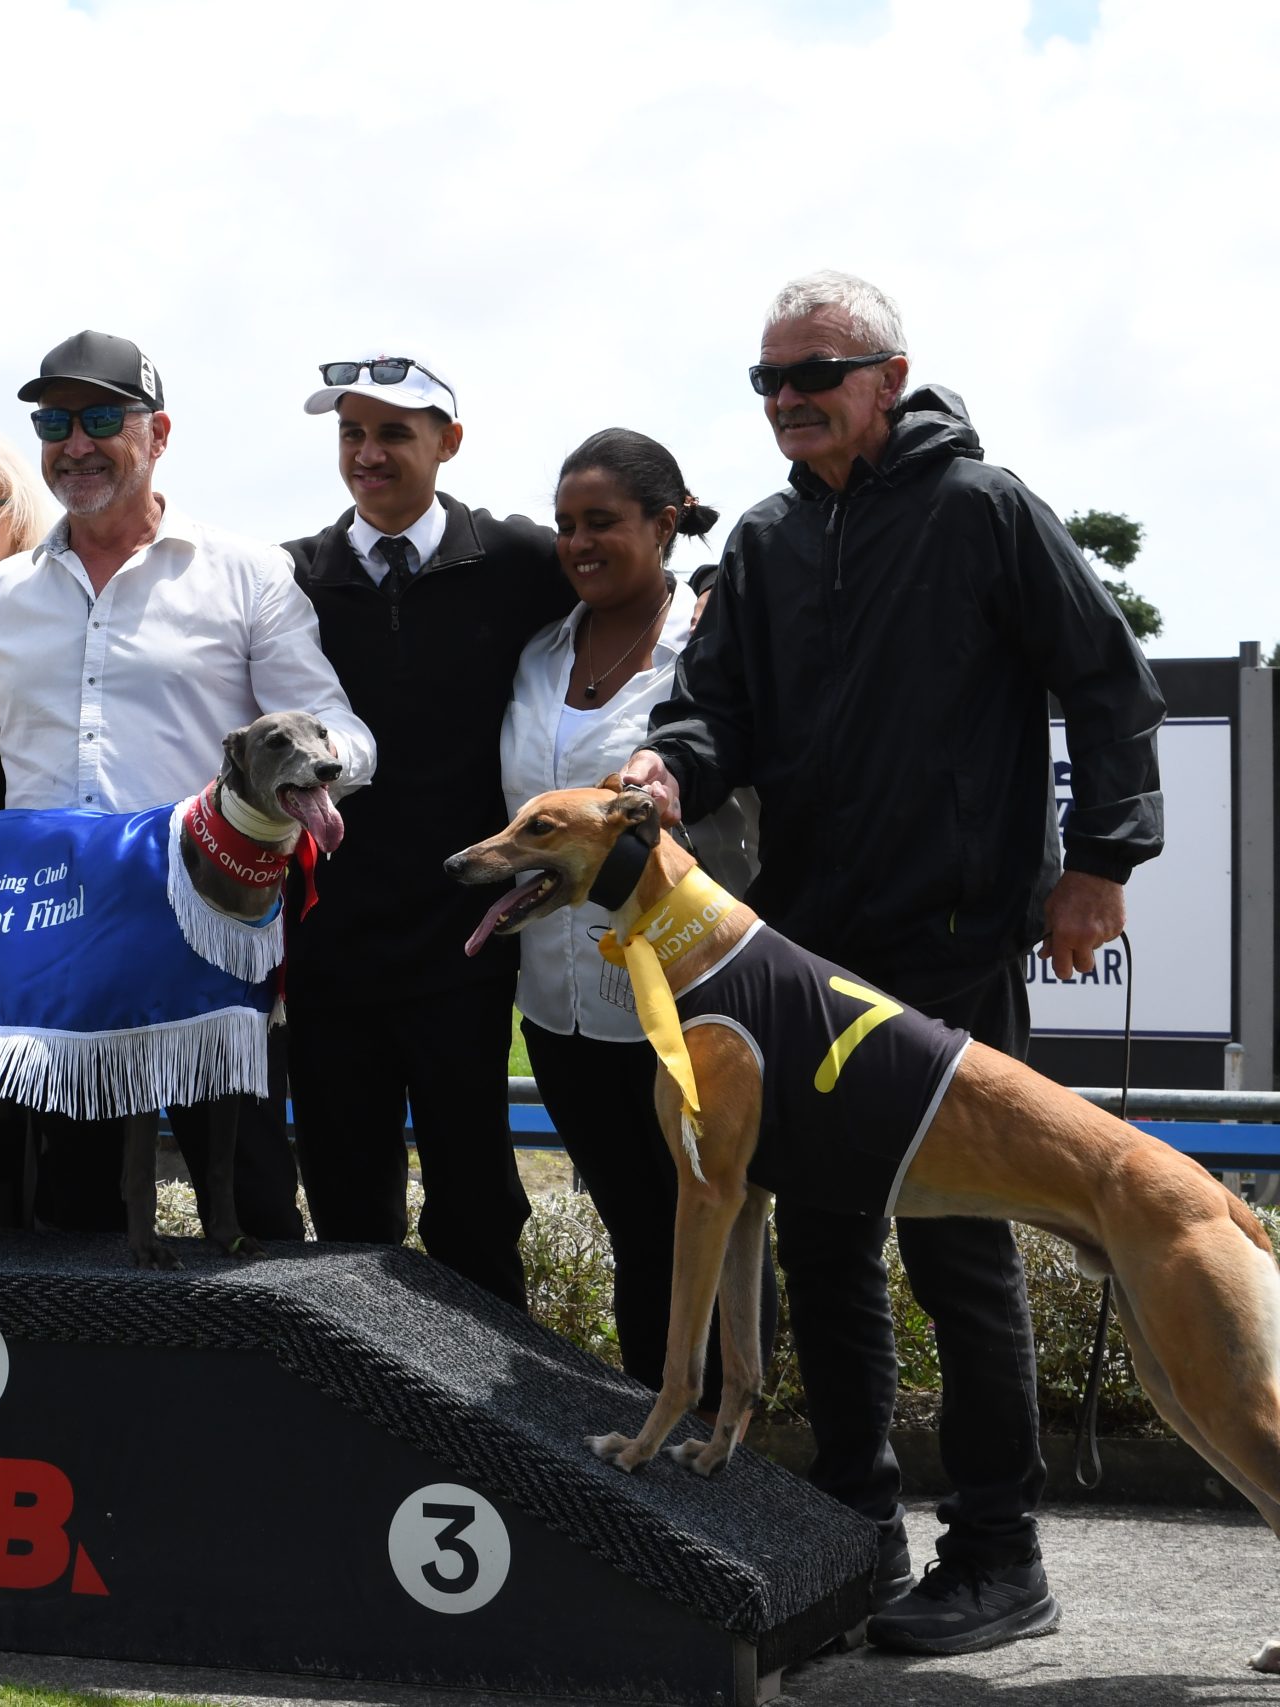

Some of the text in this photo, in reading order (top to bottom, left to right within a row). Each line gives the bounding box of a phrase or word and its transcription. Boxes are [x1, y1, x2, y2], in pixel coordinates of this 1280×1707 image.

[33, 862, 69, 887] Club
[219, 852, 283, 883] HOUND
[23, 884, 85, 932] Final
[814, 976, 904, 1092] 7
[420, 1502, 480, 1595] 3
